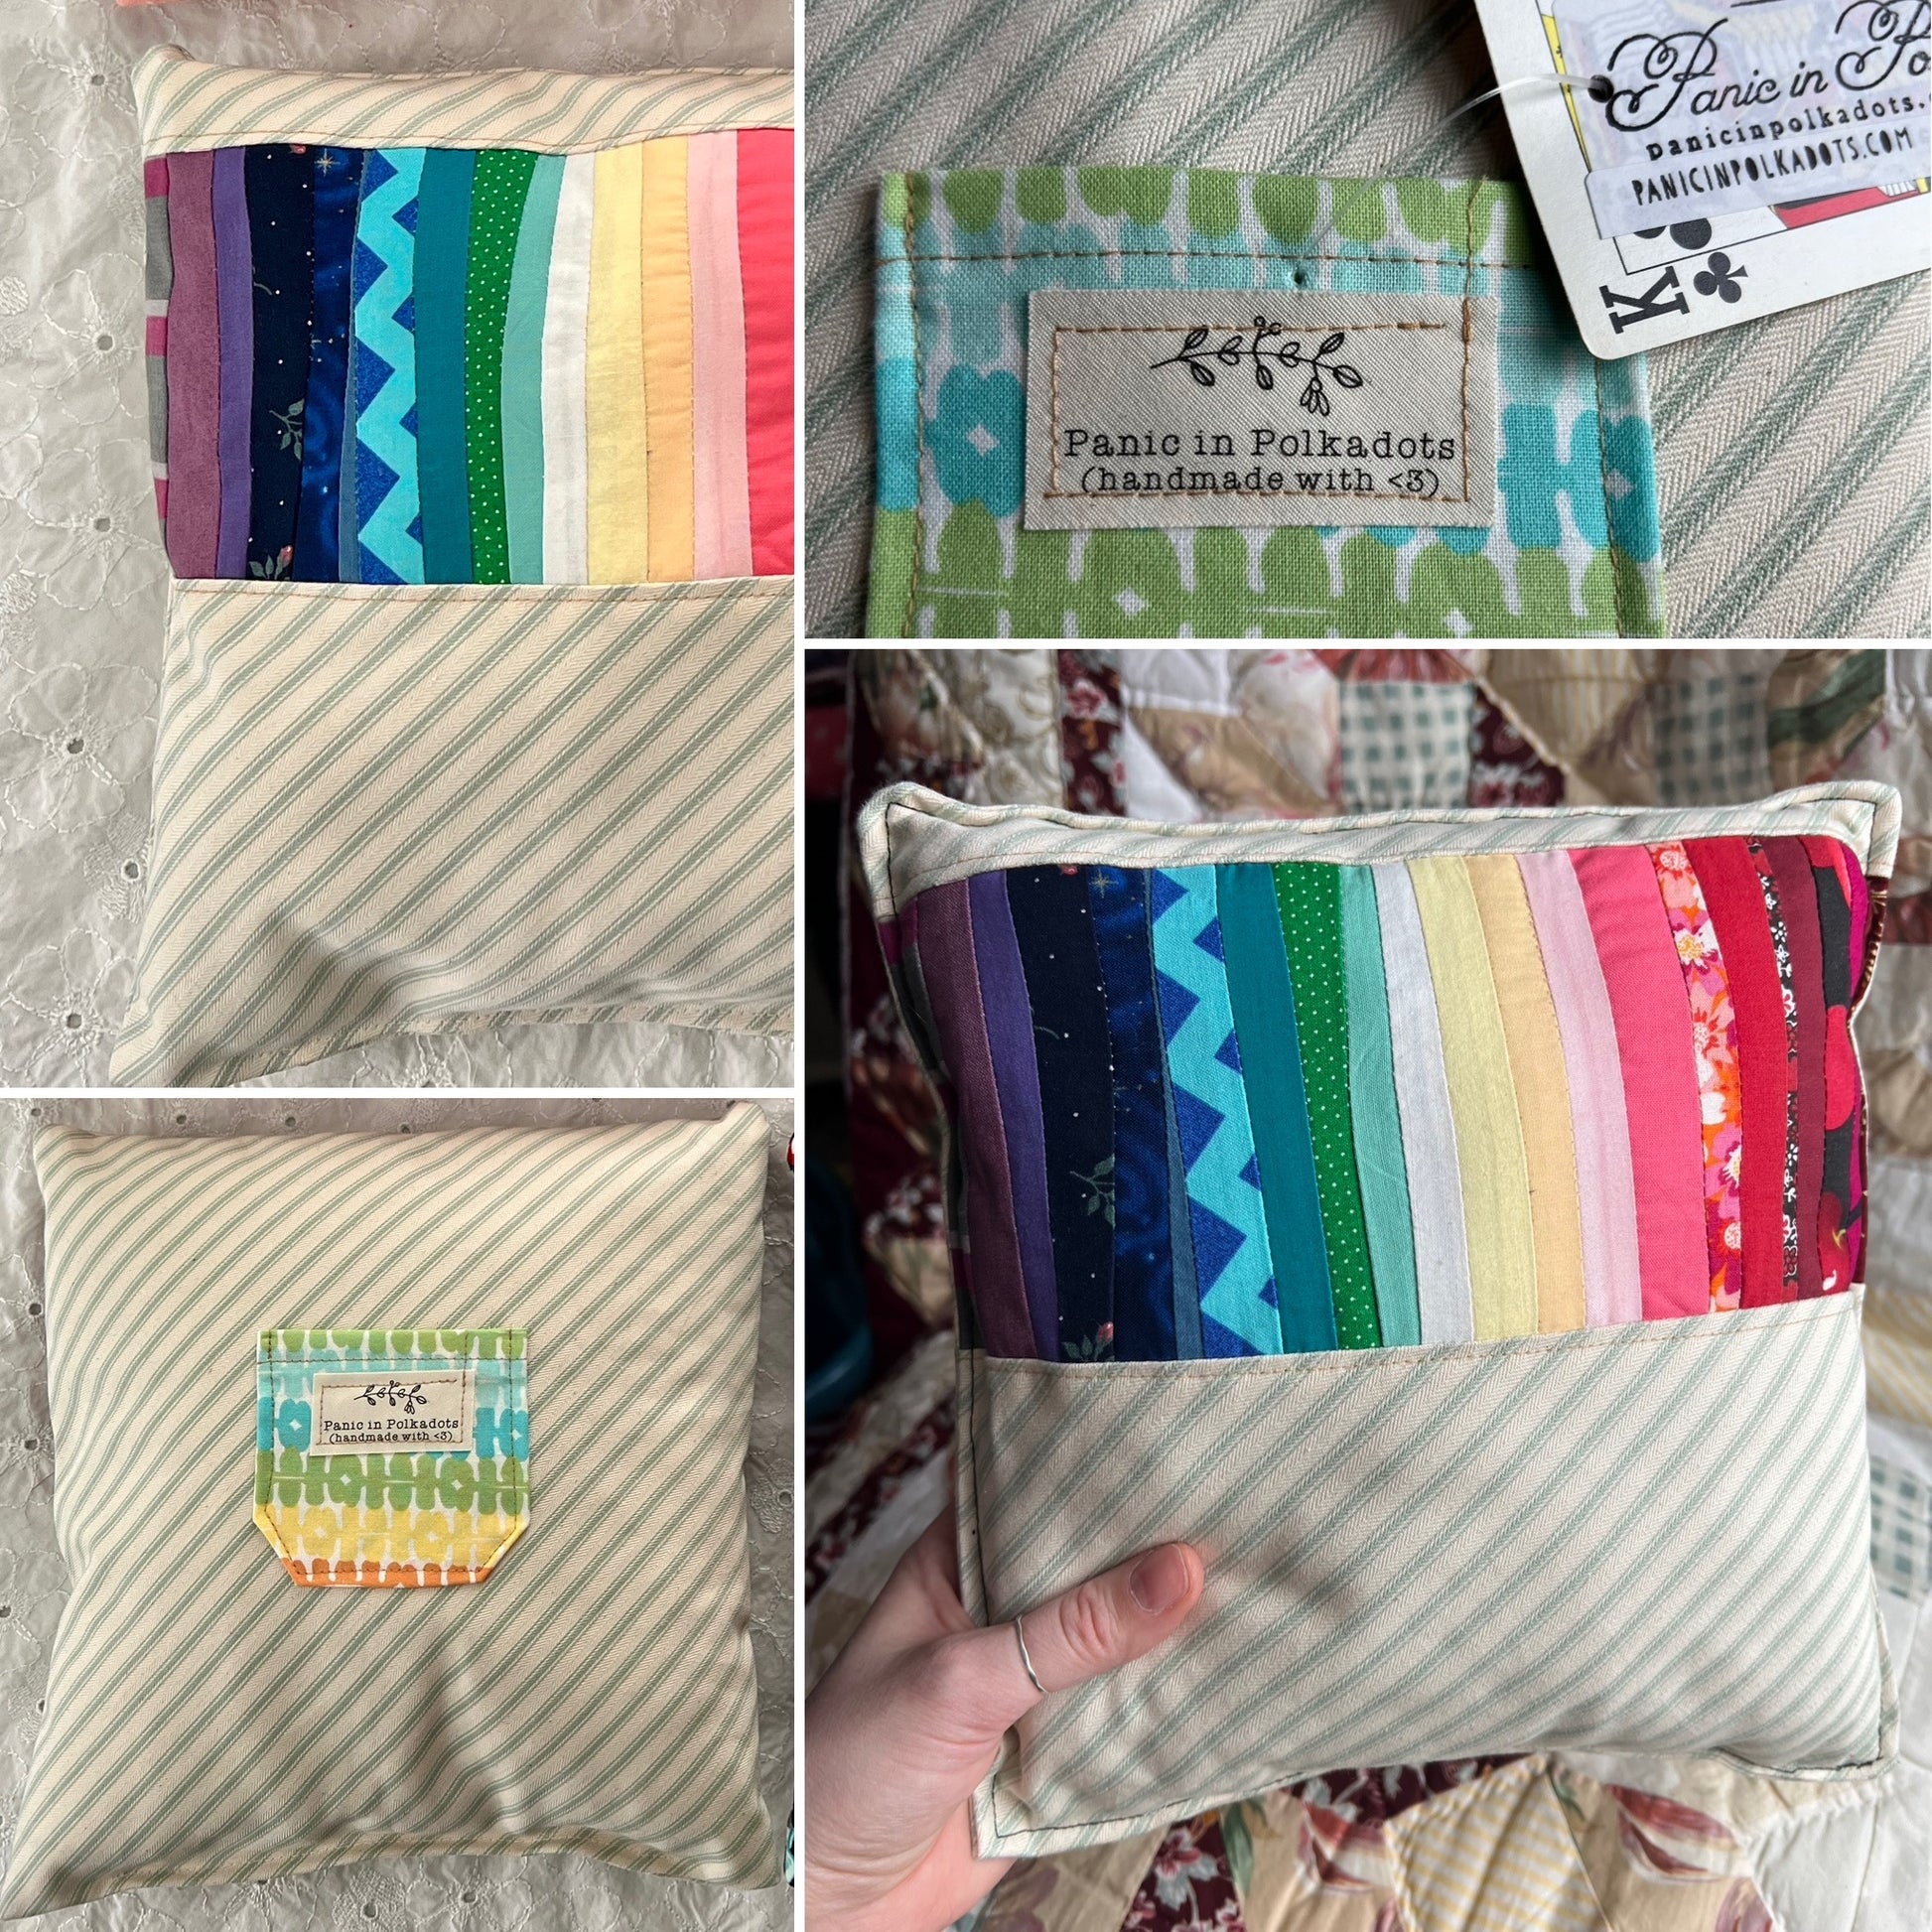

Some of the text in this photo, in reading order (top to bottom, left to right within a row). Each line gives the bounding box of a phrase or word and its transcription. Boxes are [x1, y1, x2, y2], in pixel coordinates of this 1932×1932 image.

[1605, 18, 1781, 132] Panic
[1789, 62, 1828, 96] in
[1646, 92, 1931, 161] panicinpolkadots.
[1631, 127, 1914, 206] PANICINPOLKADOTS.COM
[1599, 266, 1690, 335] K
[1064, 429, 1455, 460] Panic in Polkadots
[1081, 466, 1440, 496] (handmade with <3)
[324, 1418, 459, 1432] Panic in Polkadots
[329, 1431, 453, 1445] (handmade with <3)
